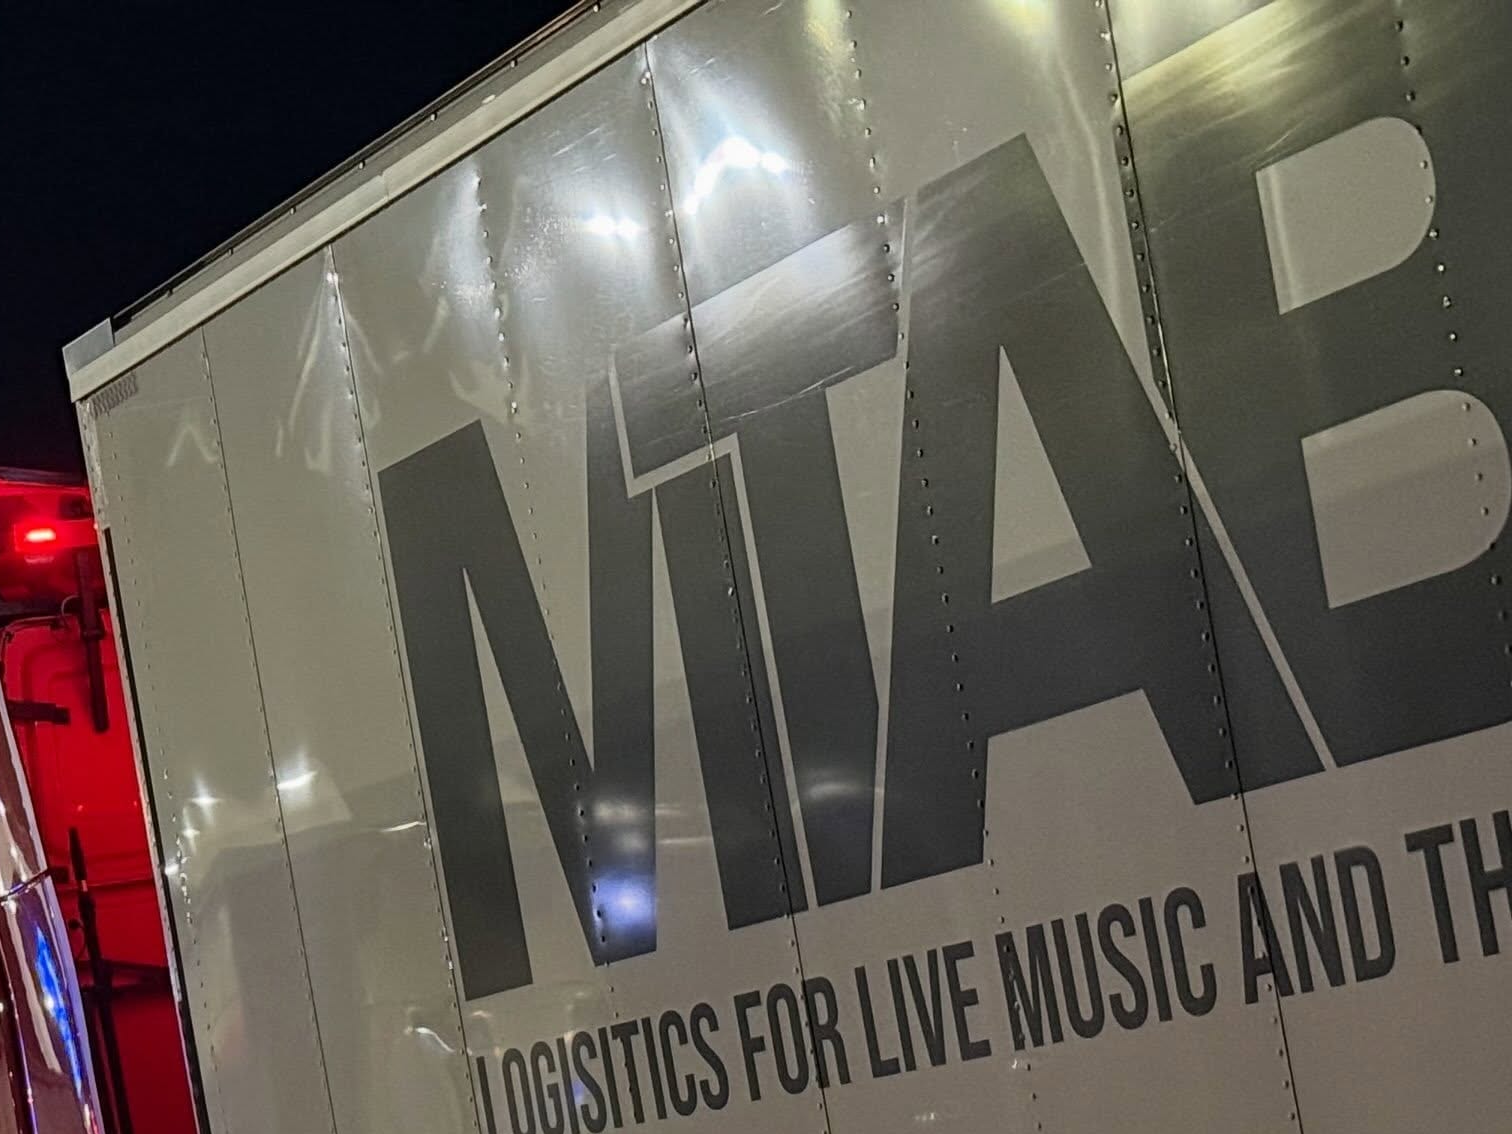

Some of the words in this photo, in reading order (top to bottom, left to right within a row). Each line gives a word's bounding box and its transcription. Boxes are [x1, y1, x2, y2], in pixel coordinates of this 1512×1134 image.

[377, 0, 1512, 1000] MTAB
[734, 975, 853, 1102] FOR
[855, 940, 993, 1079] LIVE
[996, 886, 1218, 1051] MUSIC
[1237, 844, 1396, 1005] AND
[1404, 810, 1512, 964] TH
